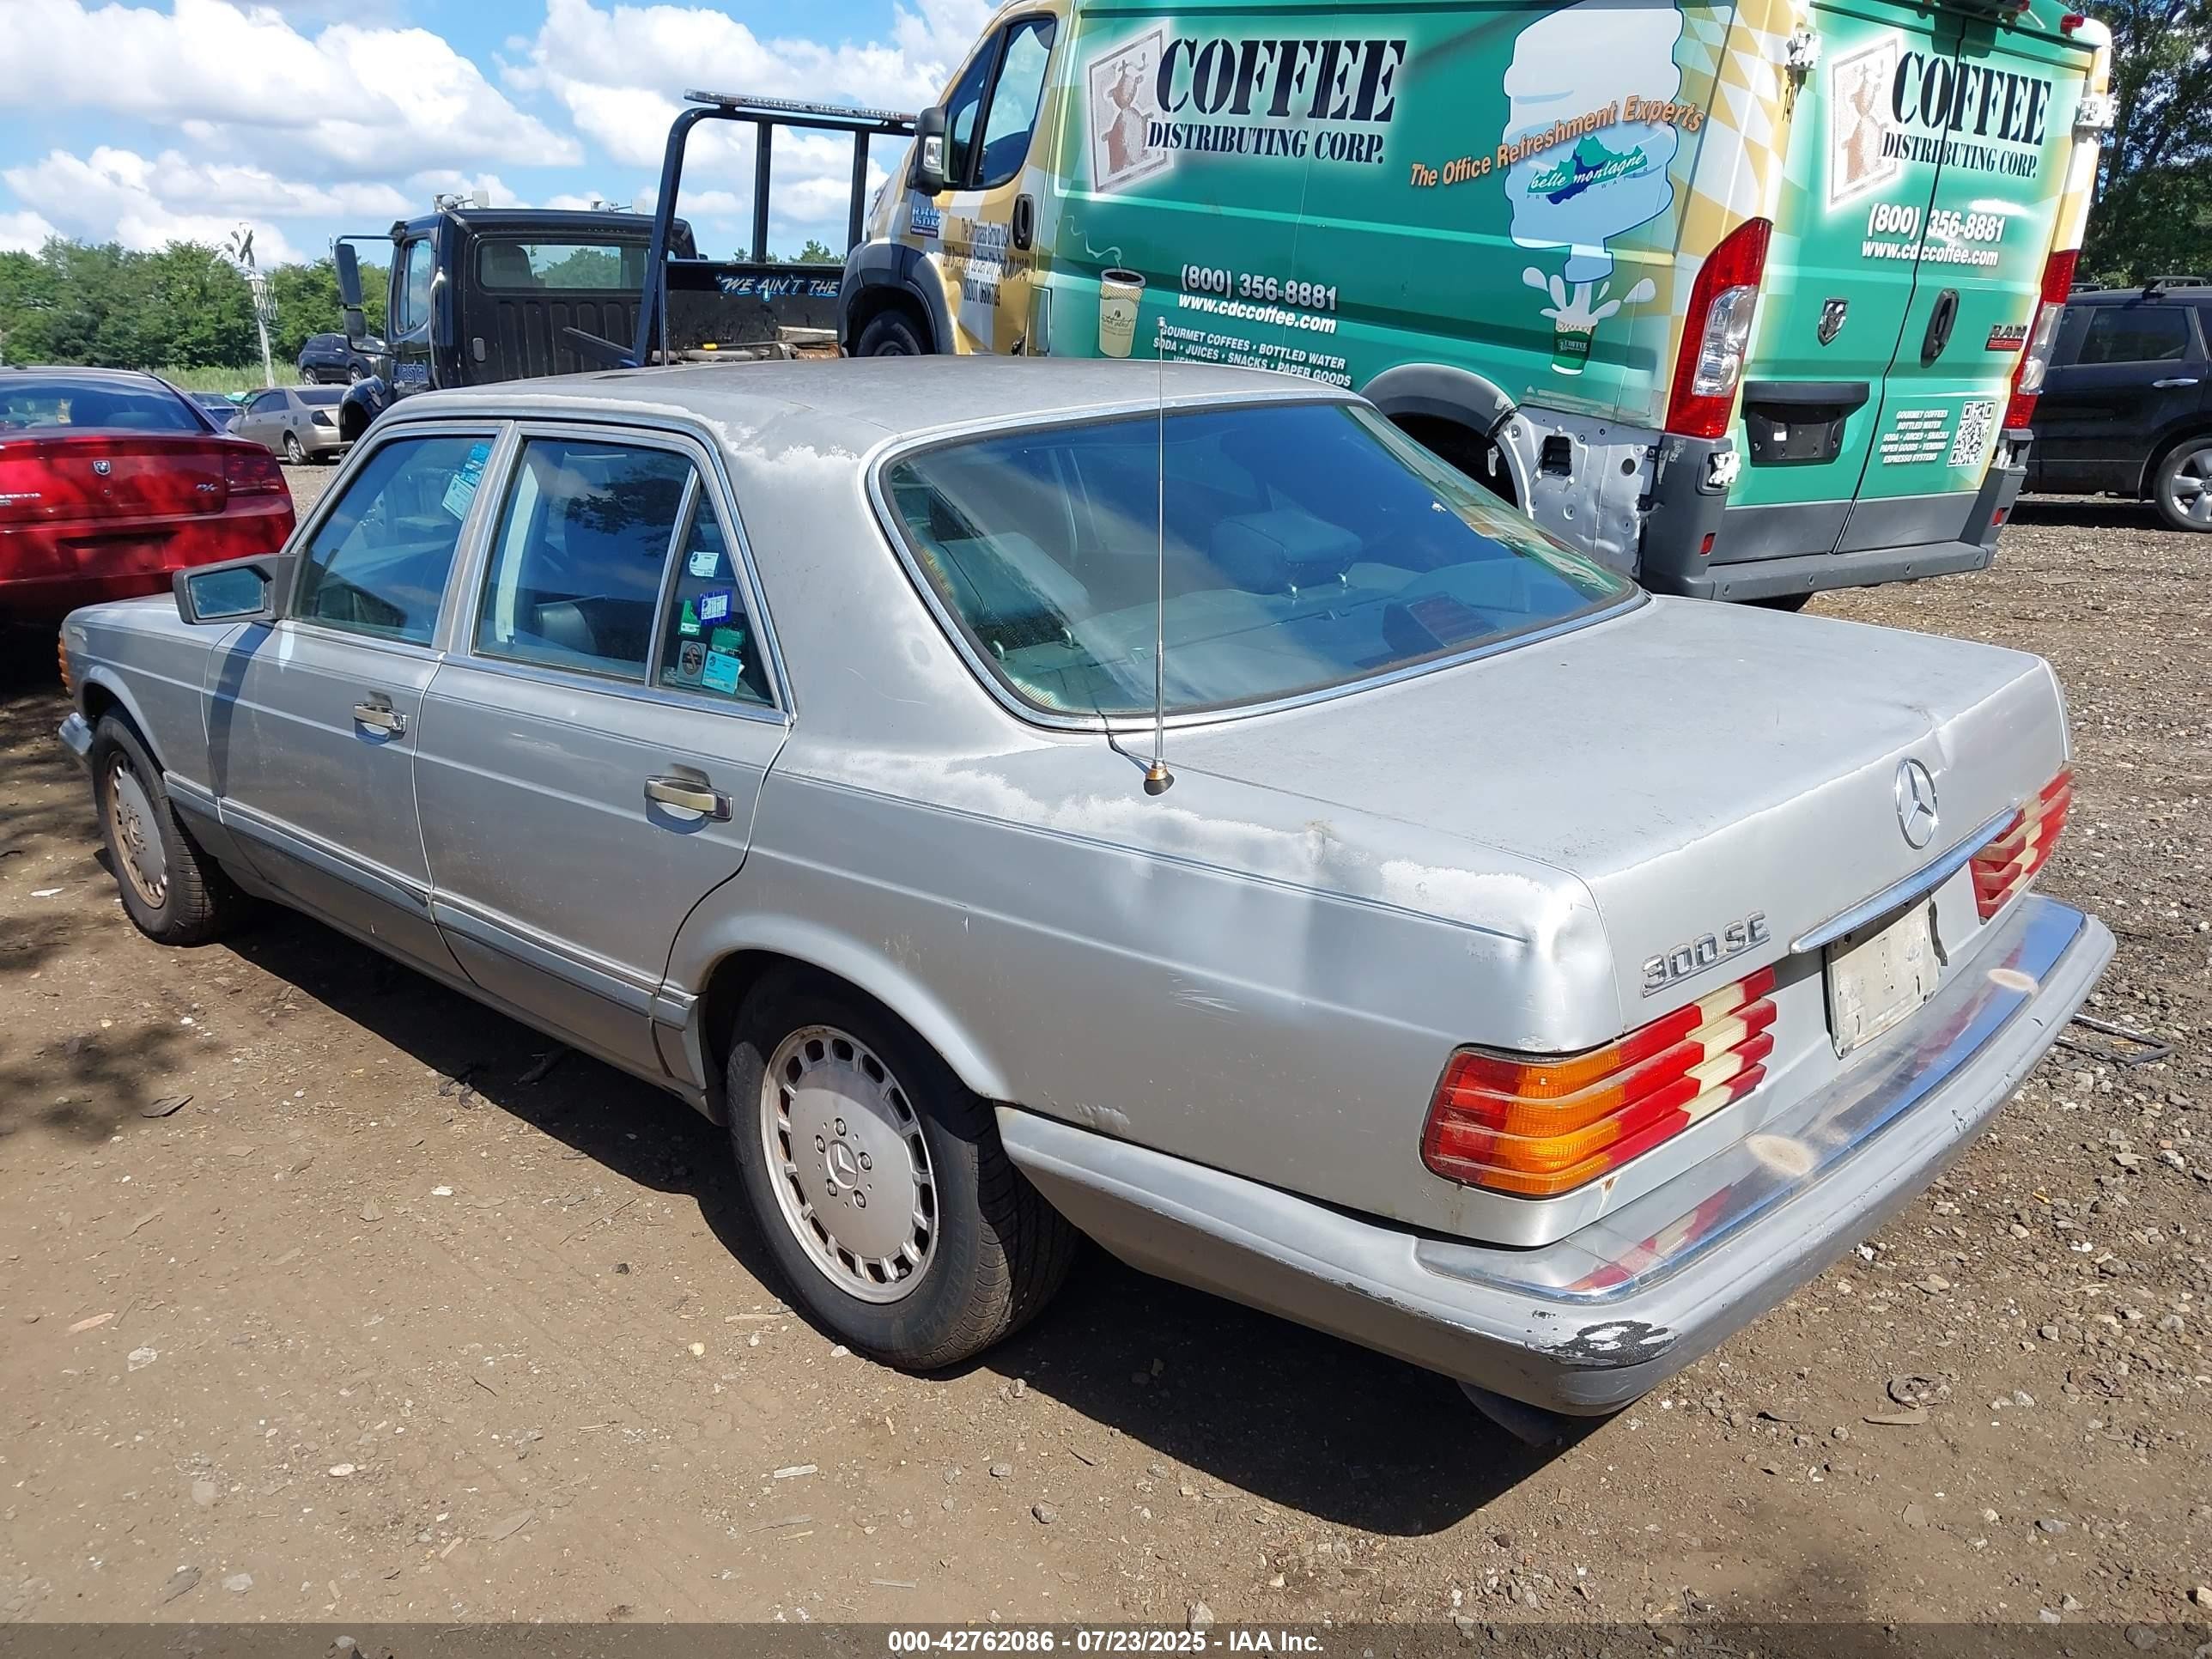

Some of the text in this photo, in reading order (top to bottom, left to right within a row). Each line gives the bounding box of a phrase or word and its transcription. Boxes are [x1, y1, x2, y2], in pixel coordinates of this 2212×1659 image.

[1157, 38, 1407, 122] COFFEE
[1892, 51, 2051, 146] COFFEE
[1147, 121, 1385, 165] DISTRIBUTING CORP.
[1410, 94, 1705, 186] The Office Refreshment Experts
[1881, 131, 2038, 179] DISTRIBUTING CORP.
[1531, 151, 1645, 189] belle montagne
[1868, 203, 2006, 242] (800) 356-8881
[1862, 240, 1998, 266] www.cdccoffee.com
[757, 275, 804, 294] AIN'T
[810, 280, 840, 294] THE
[1181, 264, 1337, 311] (800) 356-8881
[1178, 294, 1337, 334] www.cdccoffee.com
[1989, 325, 2027, 337] RAM
[1153, 337, 1177, 352] SODA
[1185, 346, 1219, 361] JUICES
[1228, 352, 1268, 369] SNACKS
[1277, 362, 1311, 379] PAPER
[1313, 370, 1352, 387] GOODS
[1161, 324, 1346, 370] GOURMET COFFEES BOTTLED WATER
[1896, 422, 1923, 430] BOTTLED
